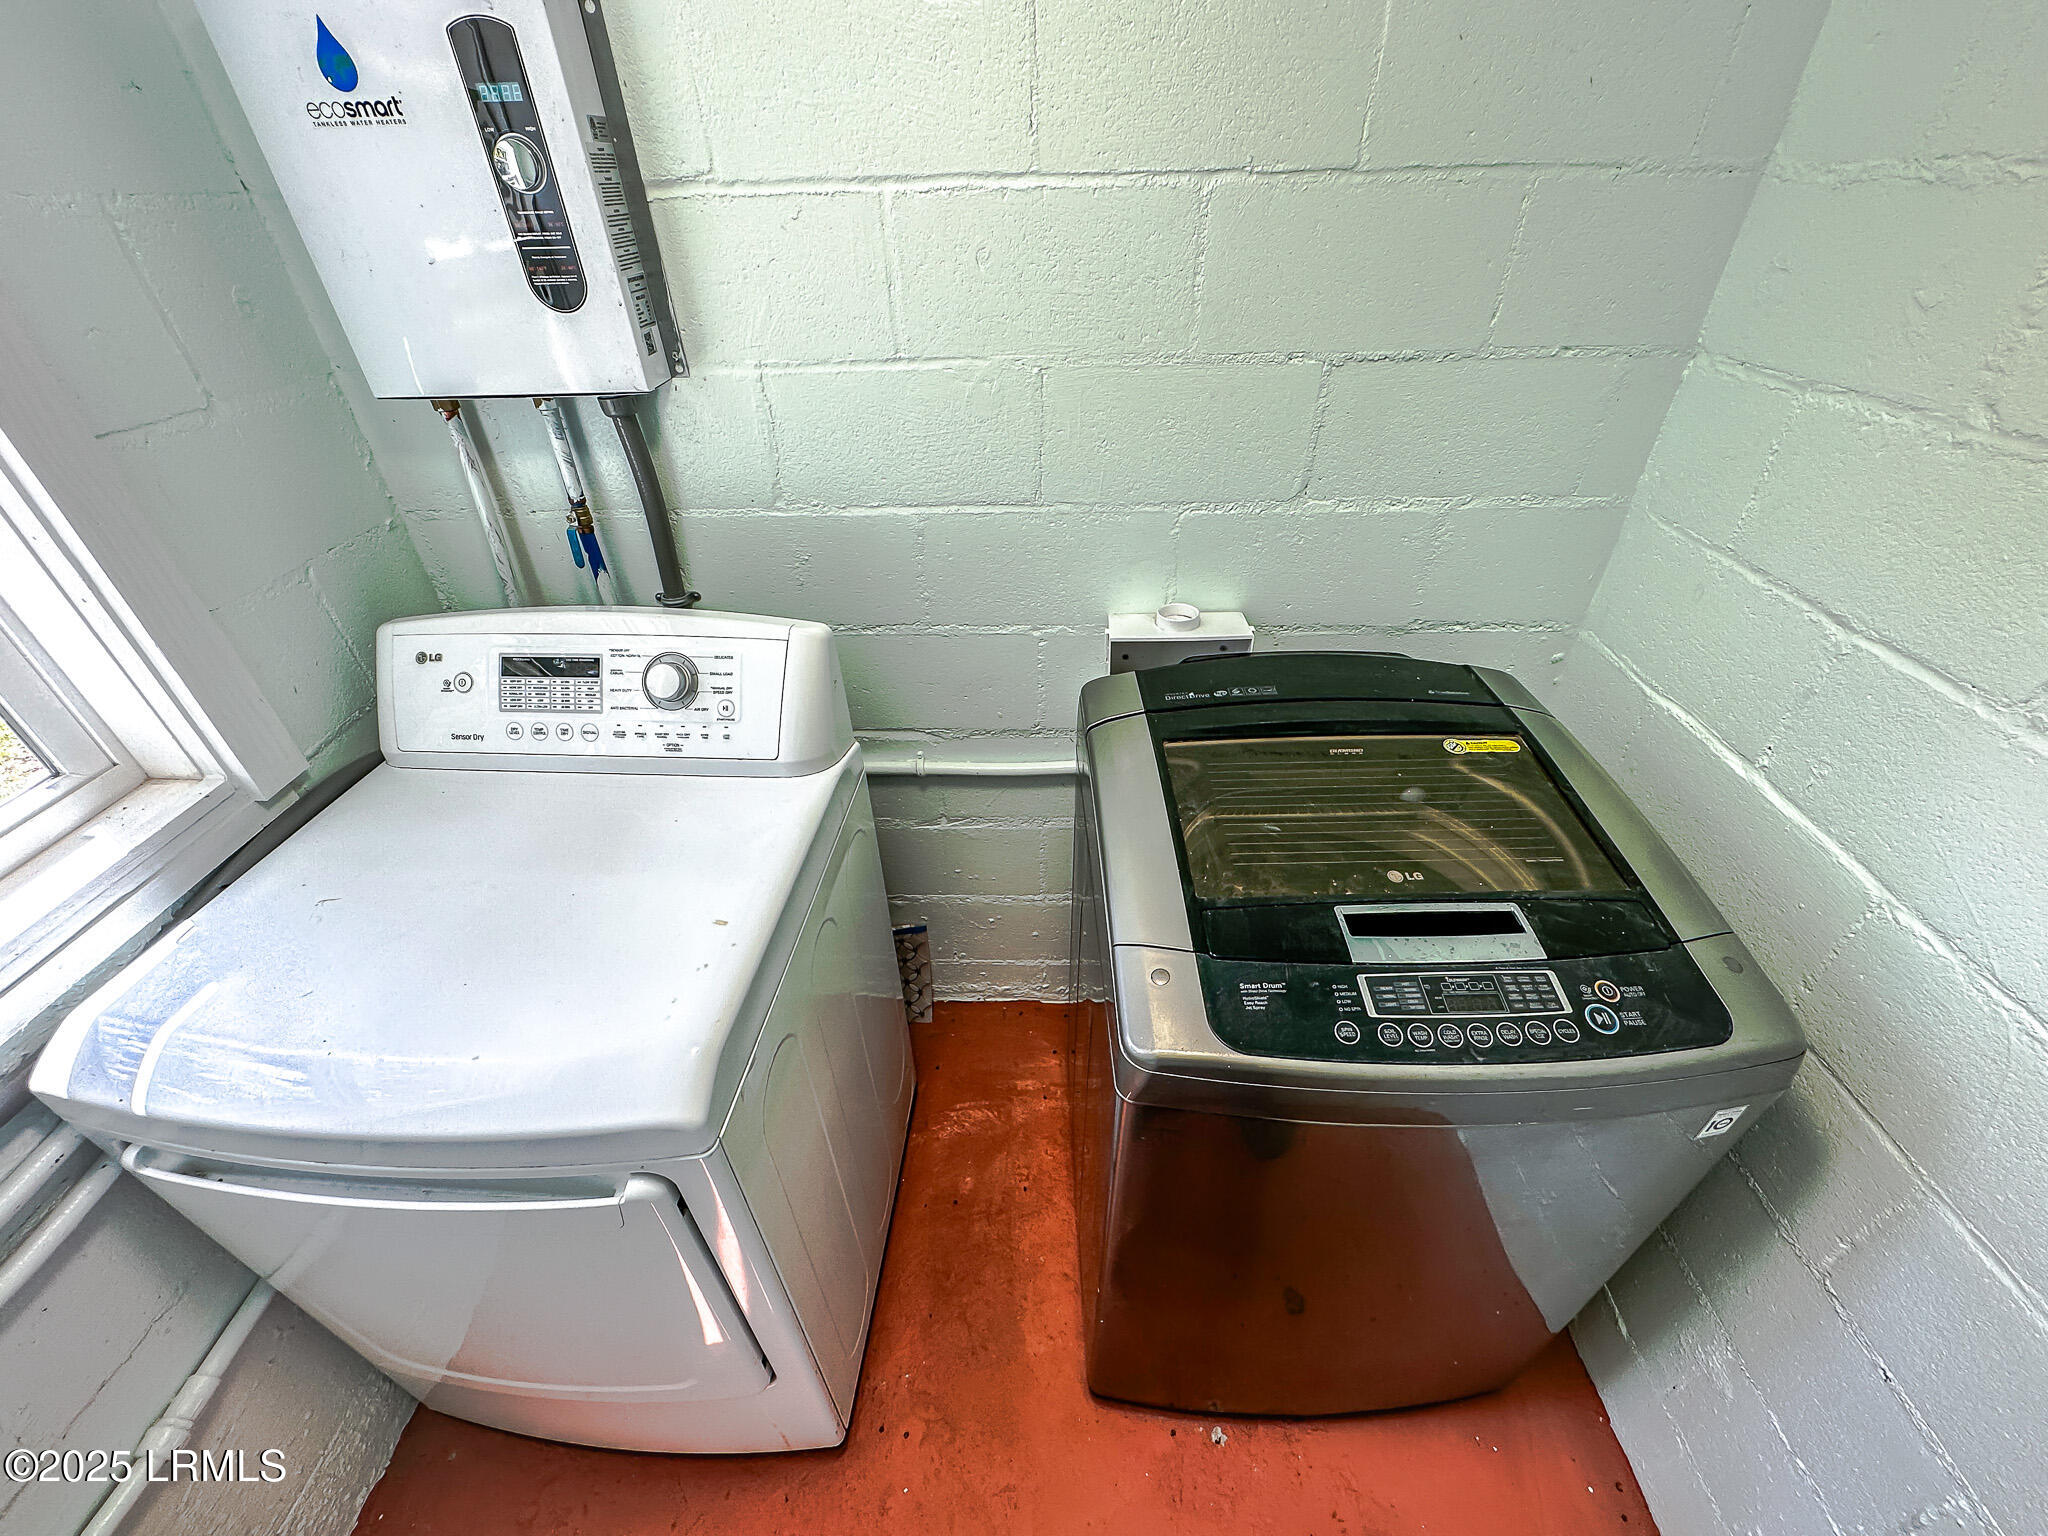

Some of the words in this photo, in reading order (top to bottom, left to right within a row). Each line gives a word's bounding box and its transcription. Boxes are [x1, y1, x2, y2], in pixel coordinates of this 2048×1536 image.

[428, 653, 443, 662] LG
[450, 733, 473, 741] Sensor
[472, 733, 485, 743] Dry
[1405, 871, 1425, 881] LG
